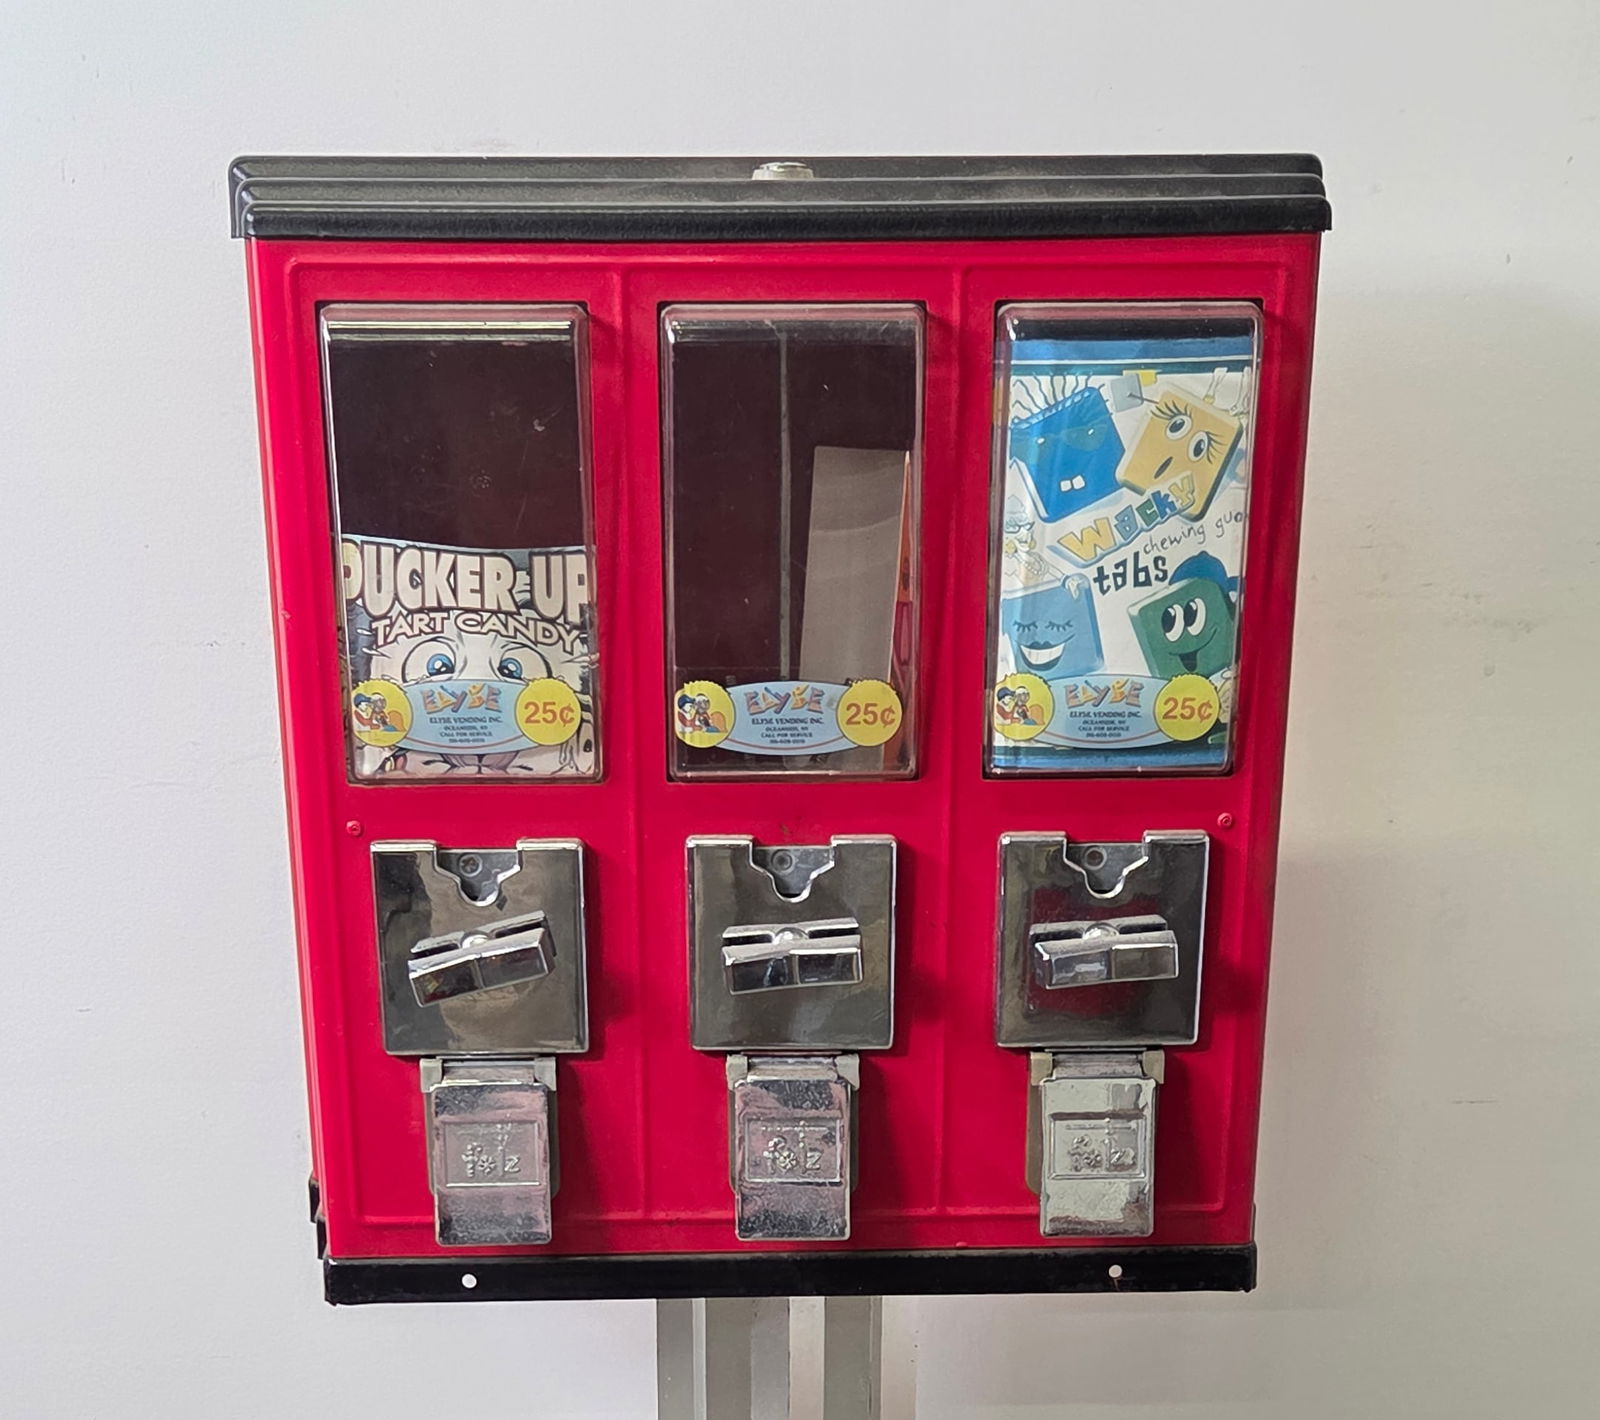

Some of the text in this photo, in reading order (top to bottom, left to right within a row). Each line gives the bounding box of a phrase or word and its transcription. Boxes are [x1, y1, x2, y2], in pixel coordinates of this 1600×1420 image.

[1143, 523, 1206, 554] chewing
[1093, 551, 1169, 596] tabs
[371, 610, 580, 654] TART CANDY
[524, 701, 576, 727] 25¢
[845, 702, 896, 729] 25¢
[1162, 697, 1213, 723] 25¢
